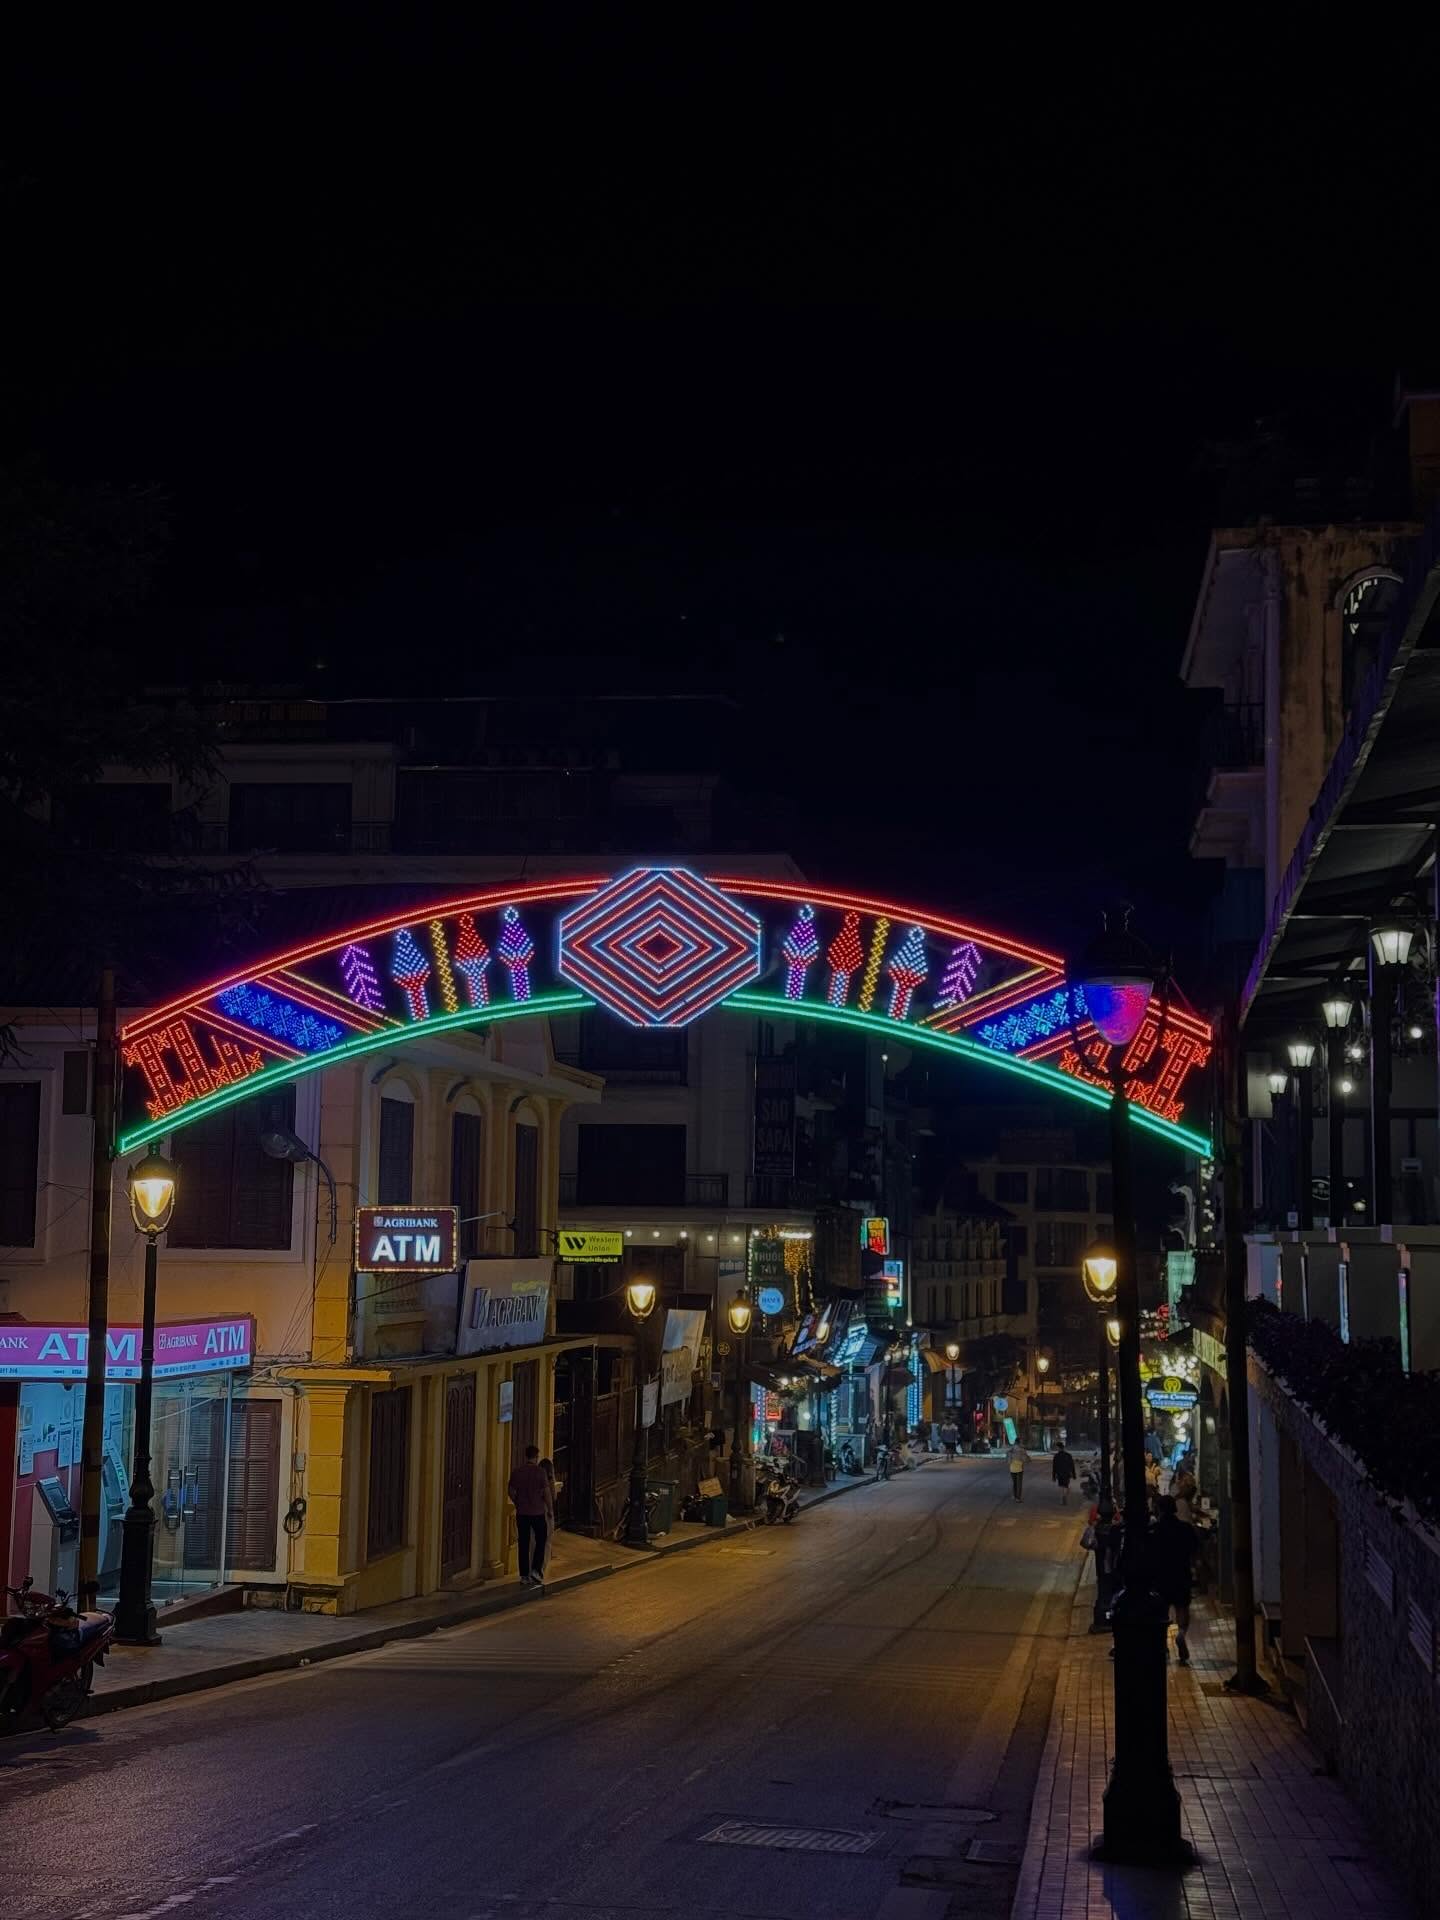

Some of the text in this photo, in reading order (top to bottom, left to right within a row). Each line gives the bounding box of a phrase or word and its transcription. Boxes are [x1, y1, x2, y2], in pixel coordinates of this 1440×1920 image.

[383, 1218, 439, 1229] AGRIBANK
[371, 1235, 441, 1262] ATM
[589, 1235, 620, 1243] Western
[37, 1333, 136, 1361] ATM
[166, 1325, 245, 1355] AGRIBANK ATM
